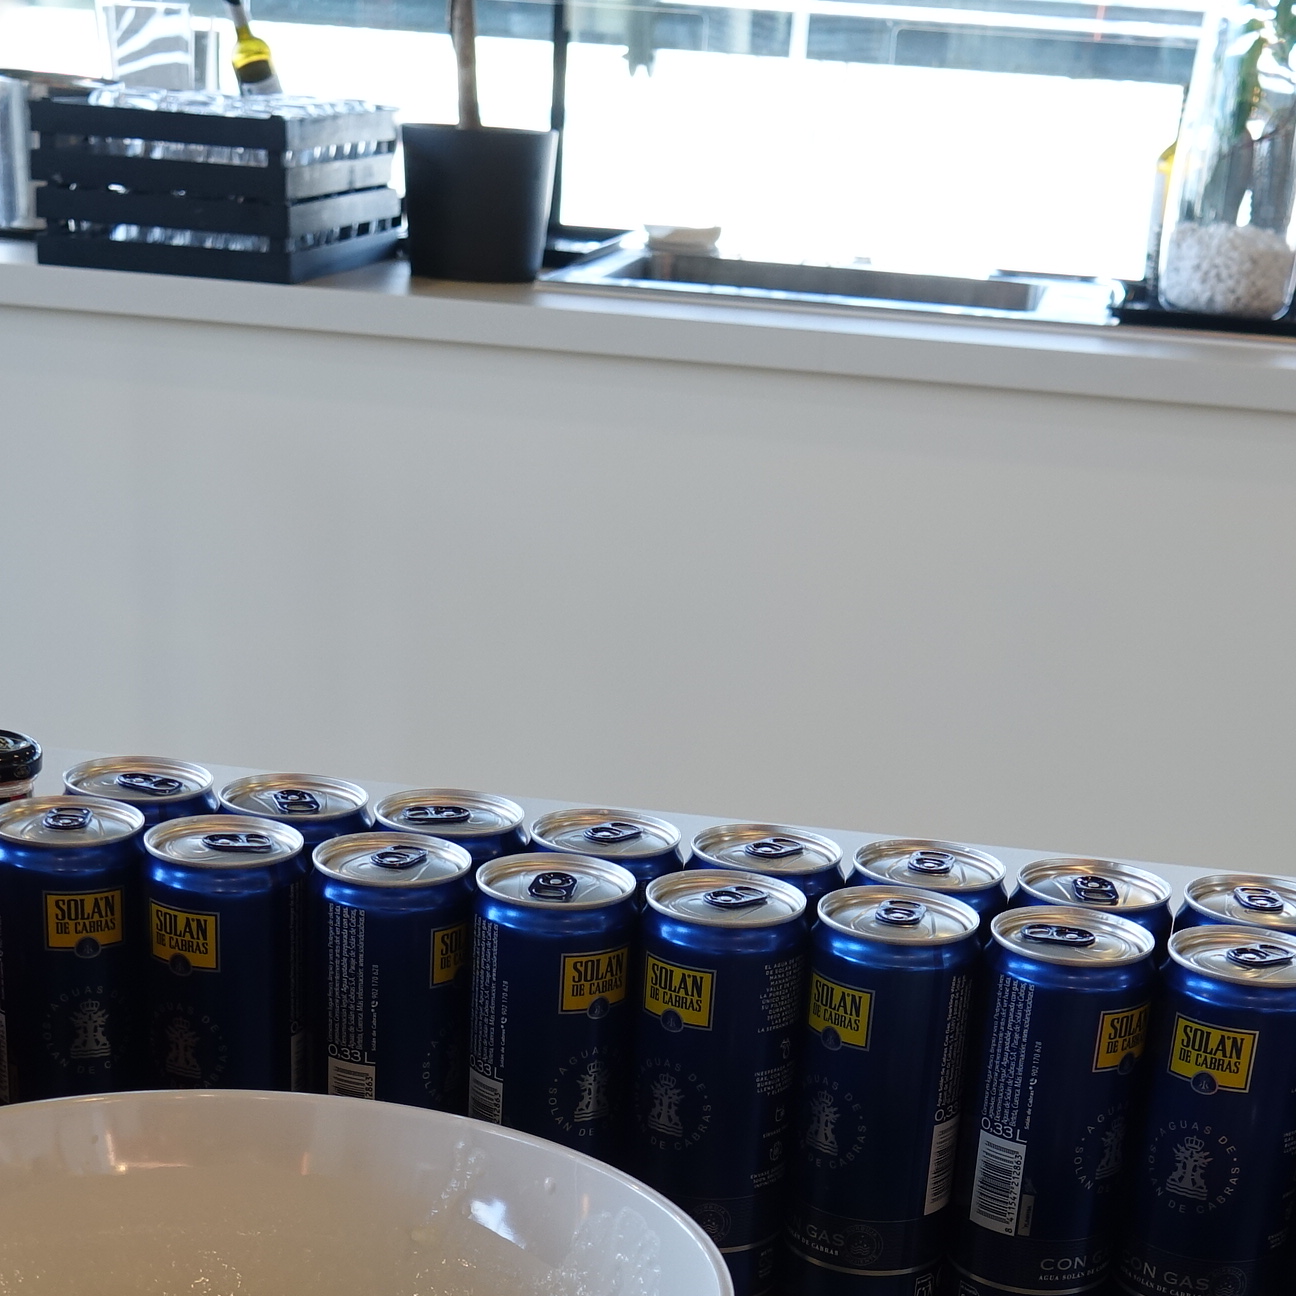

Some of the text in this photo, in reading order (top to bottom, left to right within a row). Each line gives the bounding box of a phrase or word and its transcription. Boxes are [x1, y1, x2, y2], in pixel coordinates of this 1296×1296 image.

[56, 917, 116, 935] DE CABRAS
[156, 931, 208, 955] DE CABRAS
[441, 957, 451, 969] DE
[572, 977, 623, 997] DE CABRAS
[650, 987, 702, 1012] DE CABRAS
[813, 1003, 860, 1032] DE CABRAS
[328, 1045, 376, 1065] 0,33 L
[1106, 1041, 1118, 1054] DE
[469, 1055, 504, 1082] 0,33 L
[1179, 1047, 1241, 1075] DE CABRAS
[981, 1117, 1028, 1144] 0,33 L
[1010, 1154, 1022, 1186] 212863
[1159, 1120, 1241, 1215] AGUAS DE DE CABRAS
[806, 1224, 845, 1247] GAS
[1040, 1256, 1087, 1271] CON
[1122, 1249, 1157, 1278] CON
[1163, 1271, 1210, 1291] GAS
[1038, 1274, 1059, 1282] AGUA
[1157, 1284, 1167, 1294] DE
